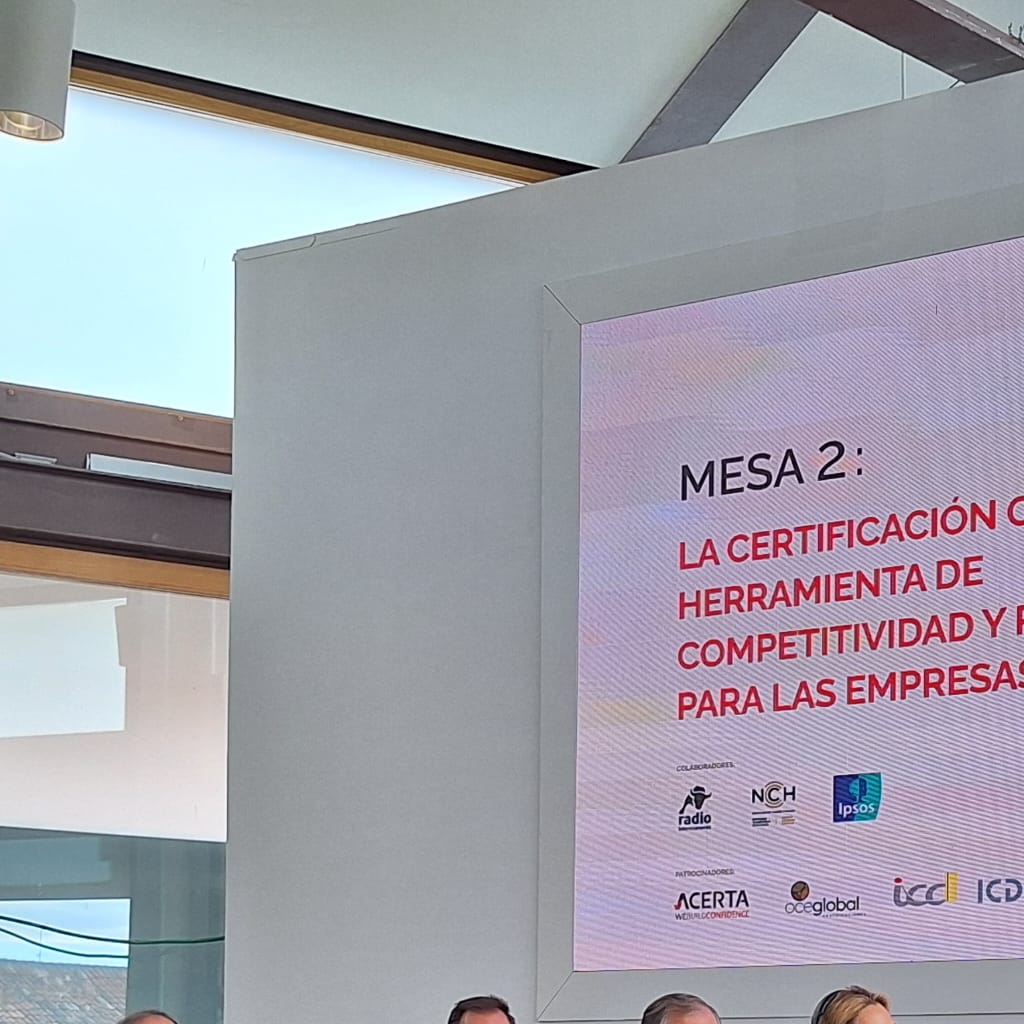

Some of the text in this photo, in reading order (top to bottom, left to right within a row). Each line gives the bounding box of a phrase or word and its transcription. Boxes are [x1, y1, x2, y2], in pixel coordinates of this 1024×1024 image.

[680, 441, 865, 501] MESA 2:
[678, 537, 720, 570] LA
[727, 496, 998, 564] CERTIFICACIÓN
[678, 555, 984, 620] HERRAMIENTA DE
[677, 611, 975, 670] COMPETITIVIDAD
[982, 607, 1008, 636] Y
[678, 684, 764, 720] PARA
[771, 678, 836, 712] LAS
[678, 813, 712, 826] radio
[752, 785, 796, 805] NCH
[674, 890, 750, 911] ACERTA
